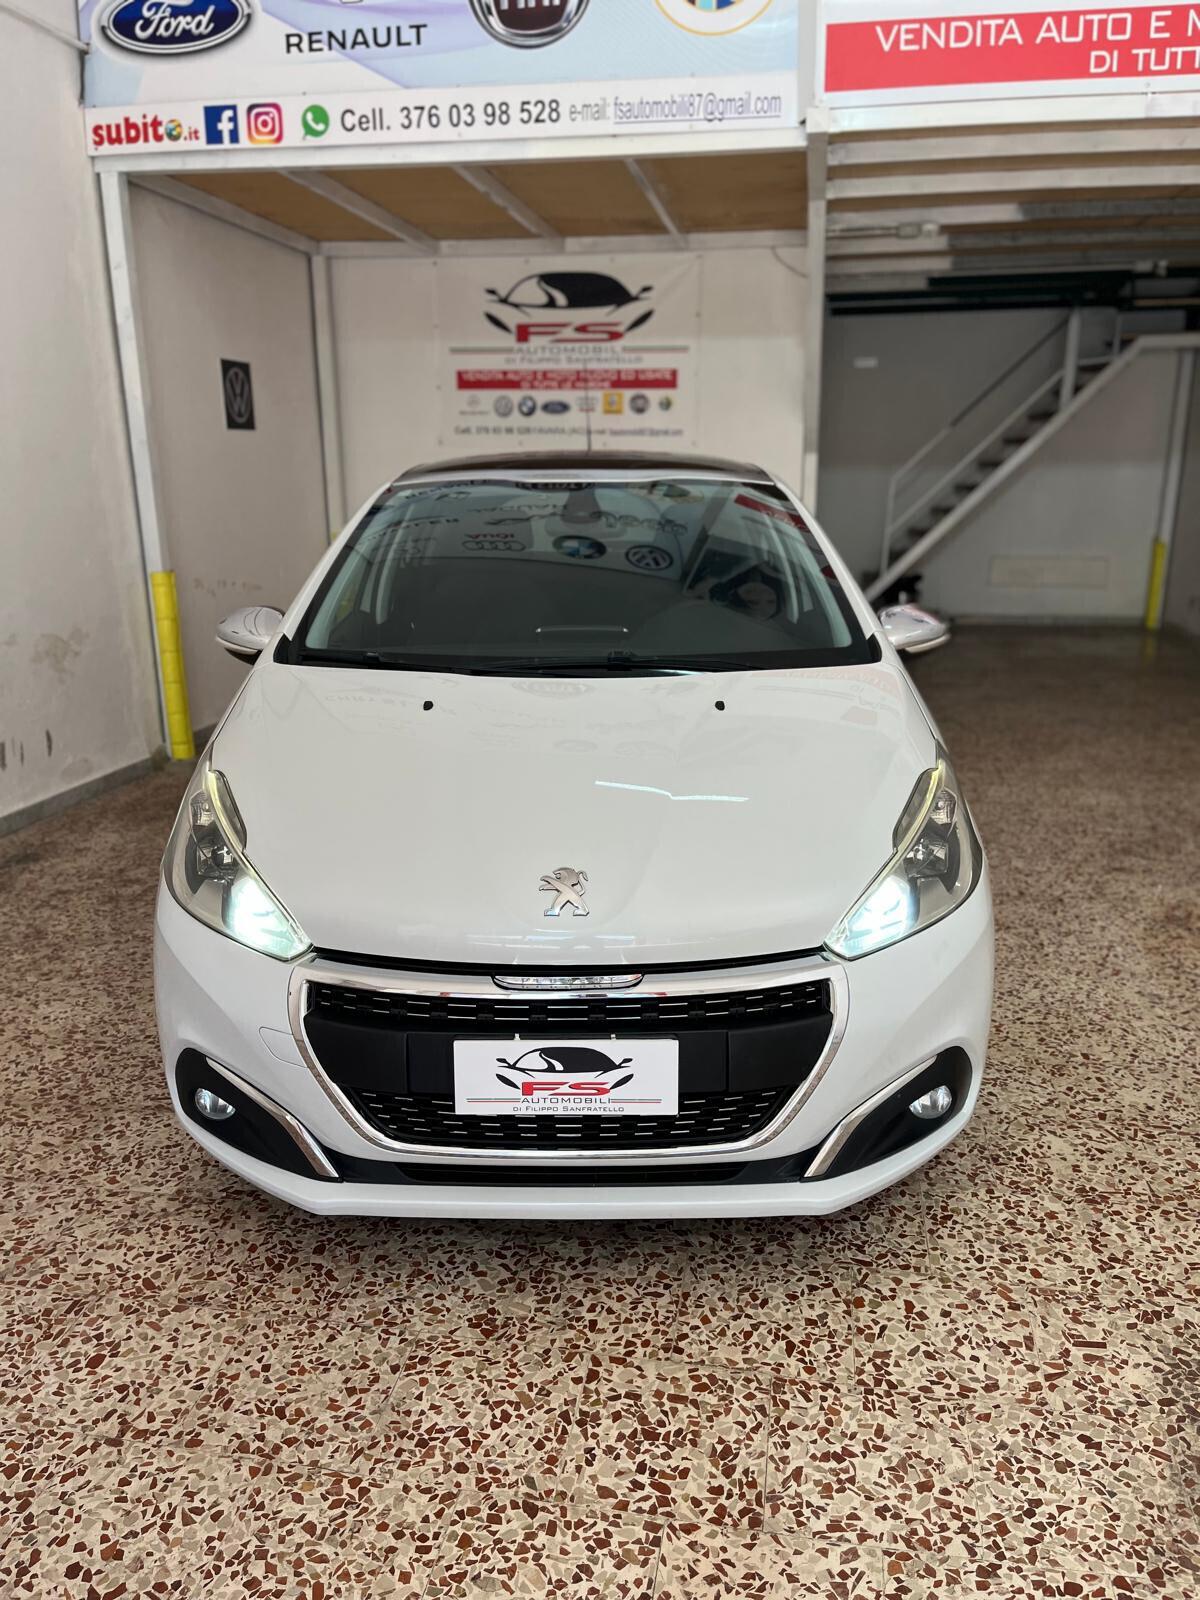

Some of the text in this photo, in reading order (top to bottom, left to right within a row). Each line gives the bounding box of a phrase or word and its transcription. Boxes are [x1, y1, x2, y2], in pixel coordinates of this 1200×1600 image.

[134, 0, 215, 39] Ford
[875, 18, 1023, 52] VENDITA
[1036, 12, 1132, 44] AUTO
[1149, 10, 1172, 39] E
[285, 24, 428, 54] RENAULT
[1089, 50, 1119, 73] DI
[340, 91, 782, 132] Cell. 376 03 98 528 e-mail: fsautomobili87@gmail.com
[515, 321, 625, 343] FS
[521, 1081, 611, 1097] FS
[524, 1105, 559, 1113] FILIPPO
[562, 1105, 625, 1113] SANFRATELLO
